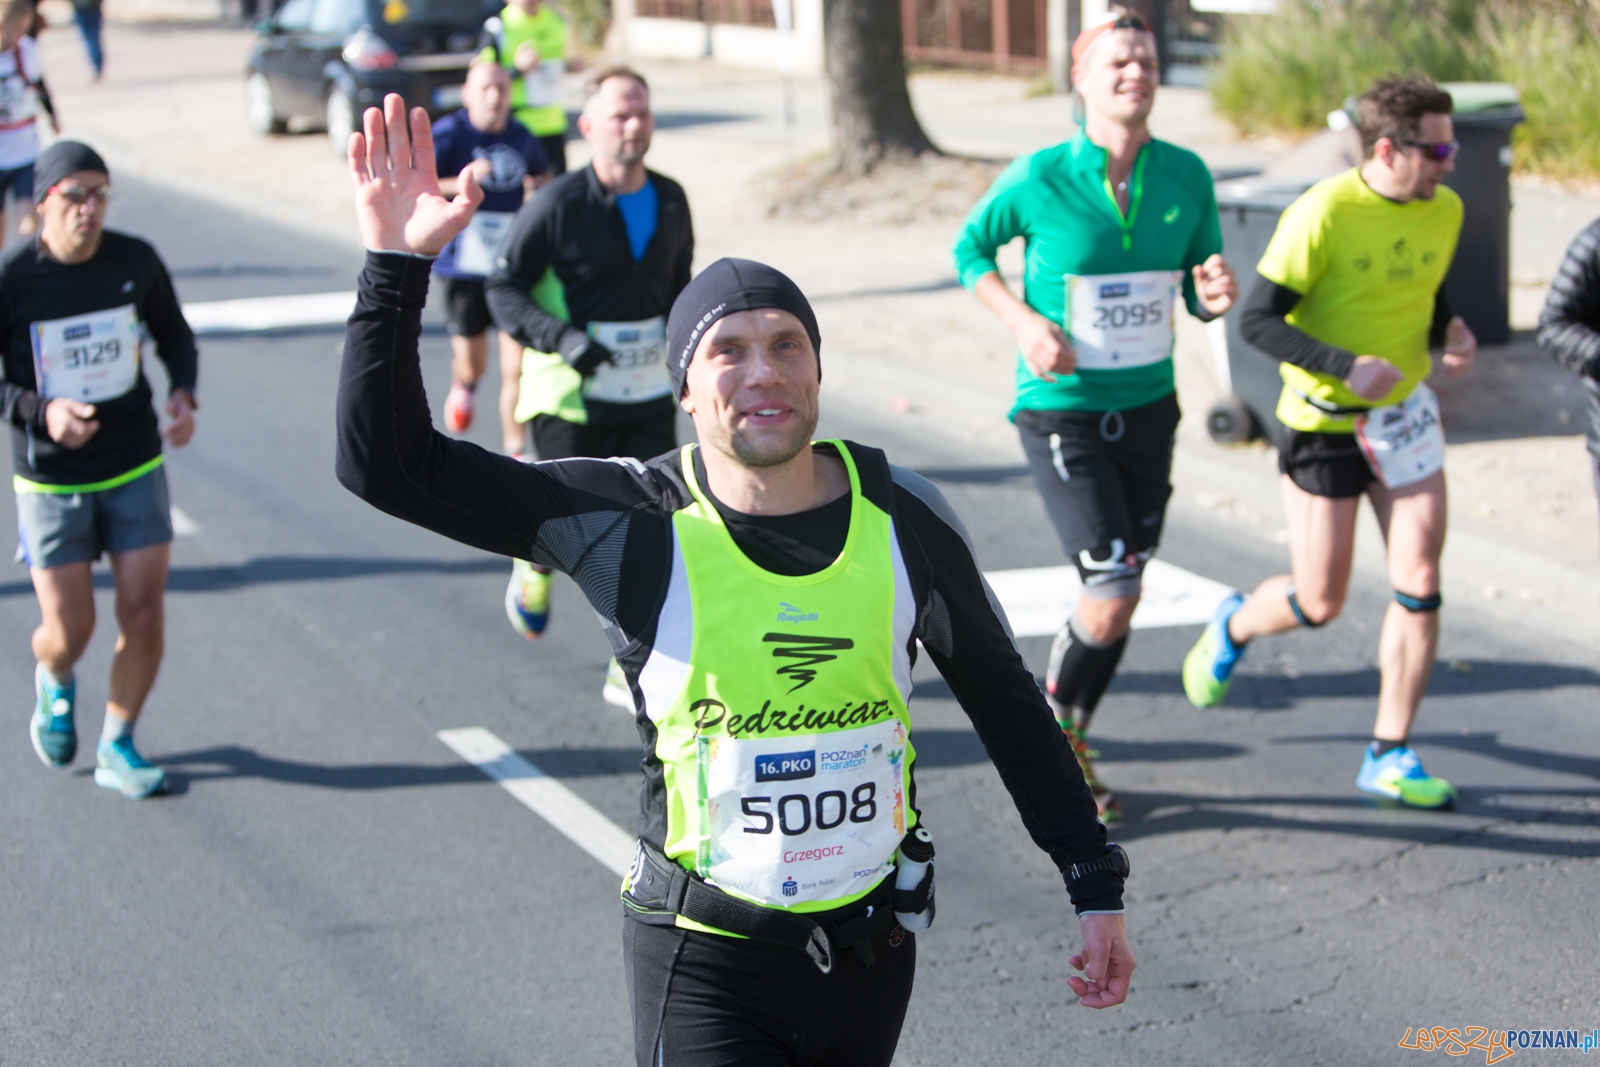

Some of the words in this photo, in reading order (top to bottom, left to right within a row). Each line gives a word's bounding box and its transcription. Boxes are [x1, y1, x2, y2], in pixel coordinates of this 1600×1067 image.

[1092, 300, 1163, 329] 2095
[62, 338, 121, 370] 3129
[776, 611, 819, 625] Rogelli
[821, 757, 866, 771] maraton
[740, 782, 877, 836] 5008
[783, 845, 844, 864] Grzegorz
